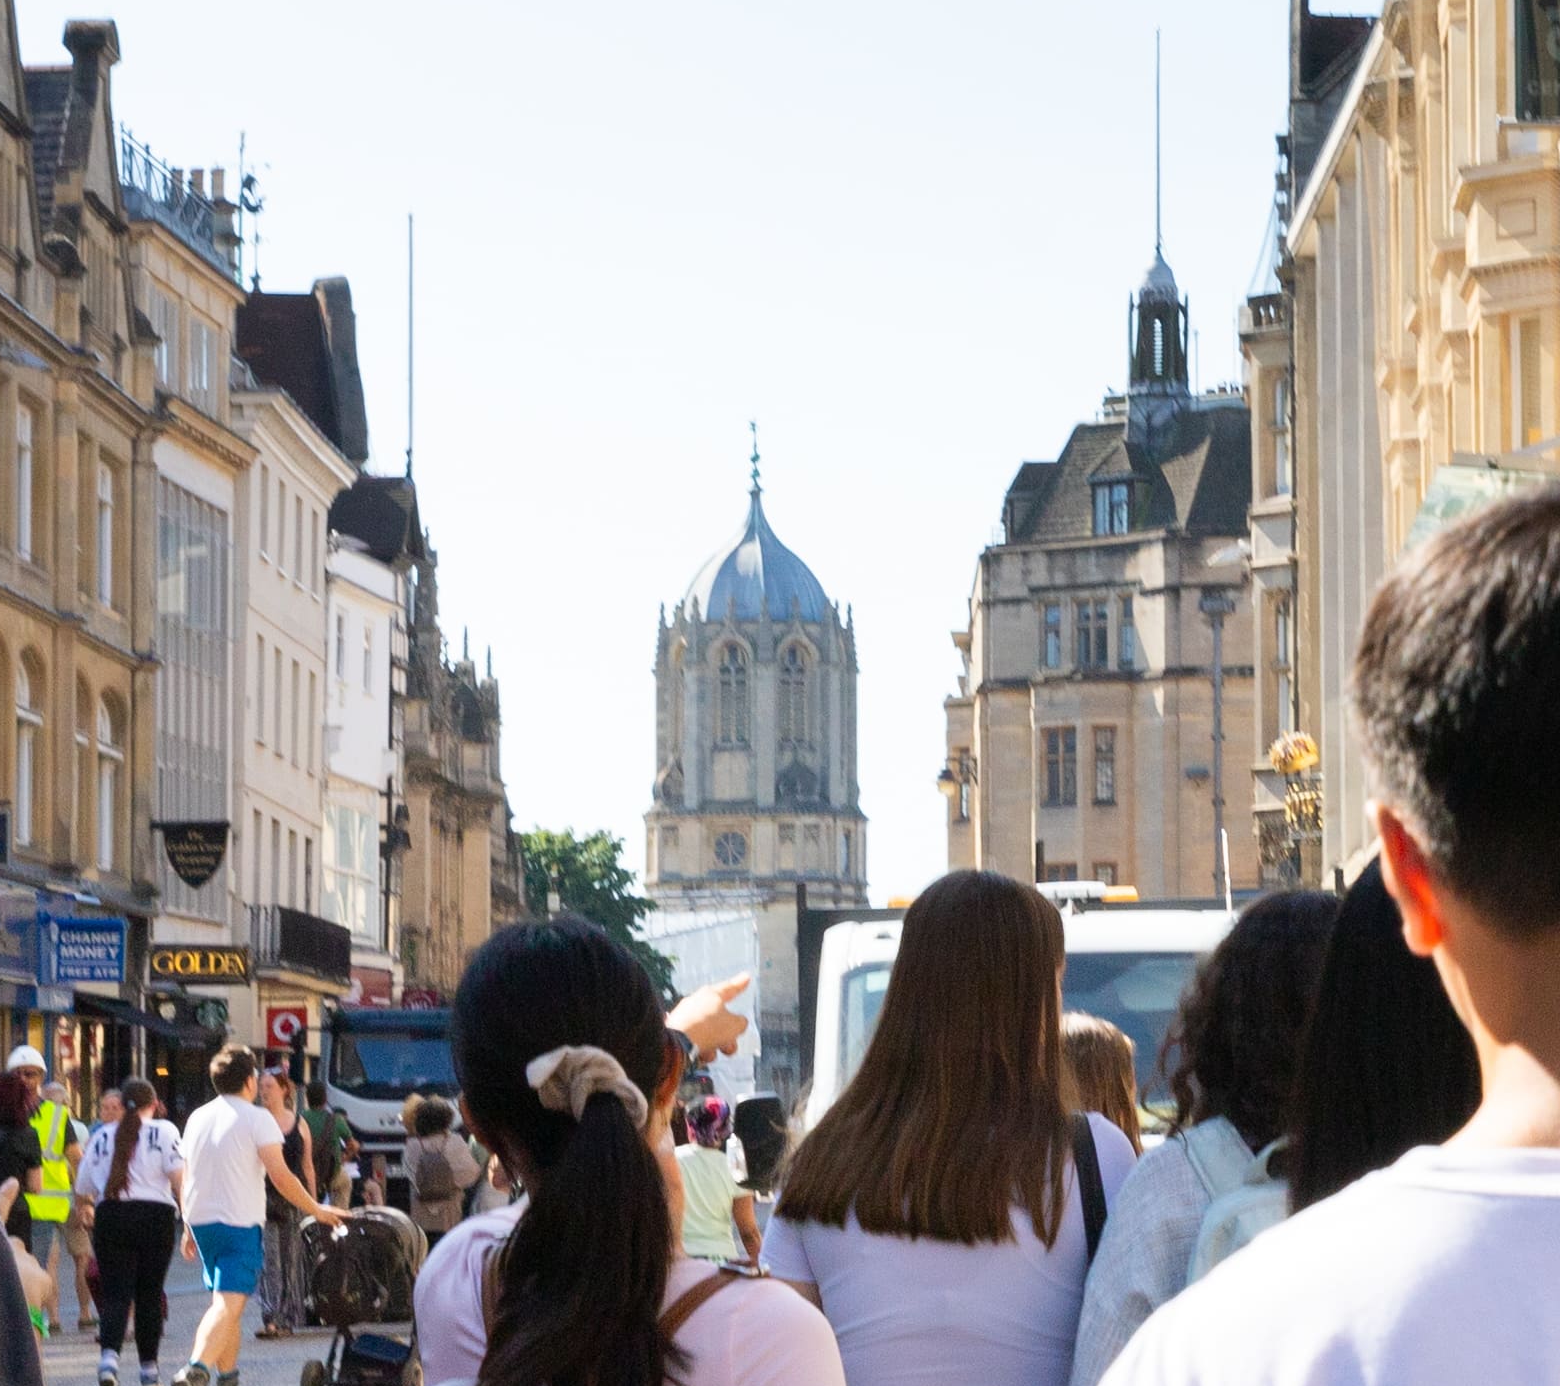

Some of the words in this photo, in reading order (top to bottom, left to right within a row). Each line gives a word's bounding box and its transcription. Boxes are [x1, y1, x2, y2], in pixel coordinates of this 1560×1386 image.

[60, 930, 121, 945] CHANGE
[60, 944, 120, 960] MONEY
[151, 948, 248, 977] GOLDEN
[60, 965, 90, 979] FREE
[93, 965, 120, 979] ATM
